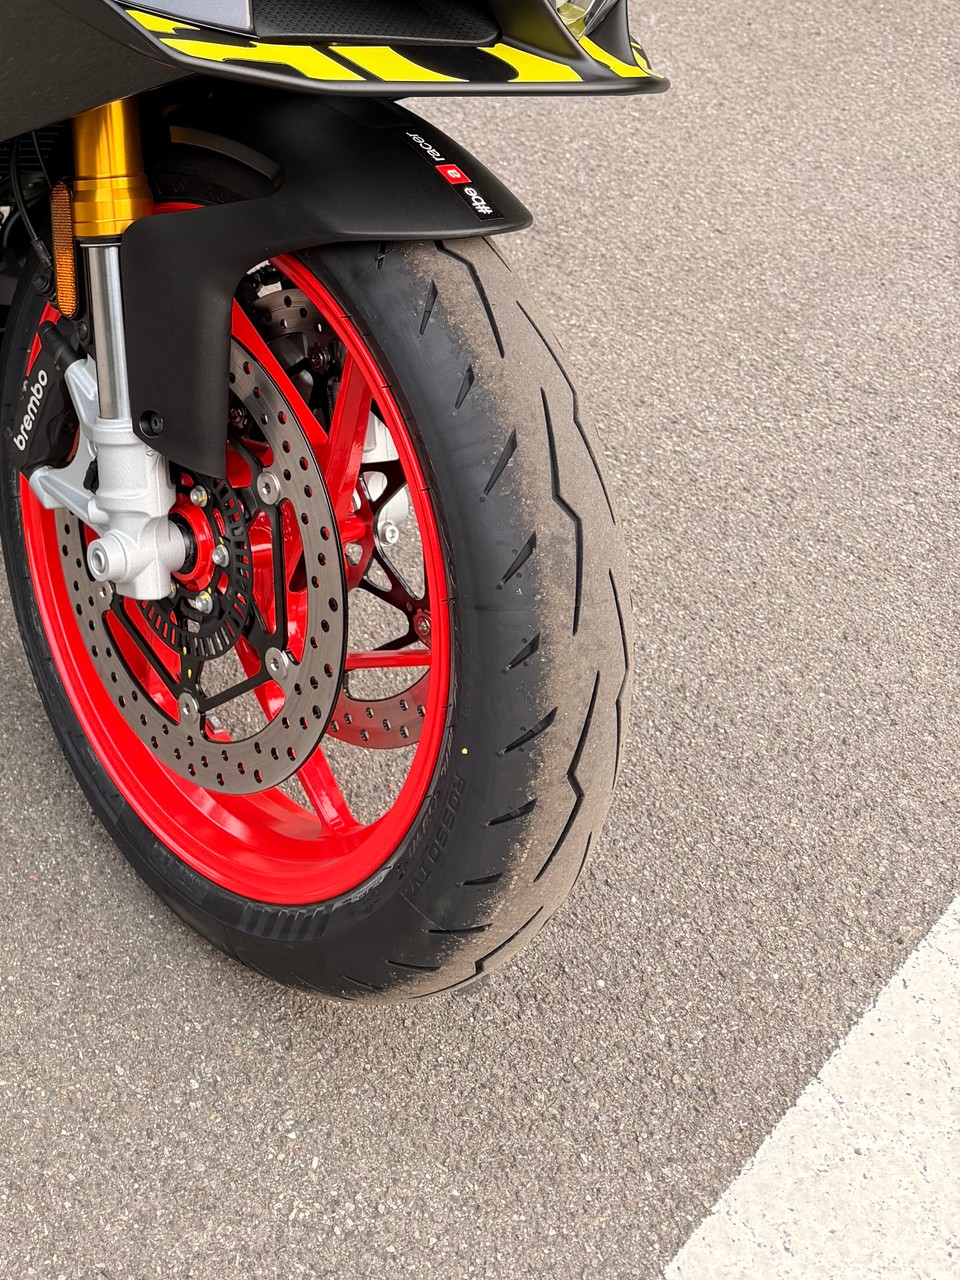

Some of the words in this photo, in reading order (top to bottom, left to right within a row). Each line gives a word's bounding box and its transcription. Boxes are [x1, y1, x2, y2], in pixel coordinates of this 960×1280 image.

[406, 131, 445, 162] racer
[464, 186, 494, 216] #be
[13, 369, 48, 451] brembo
